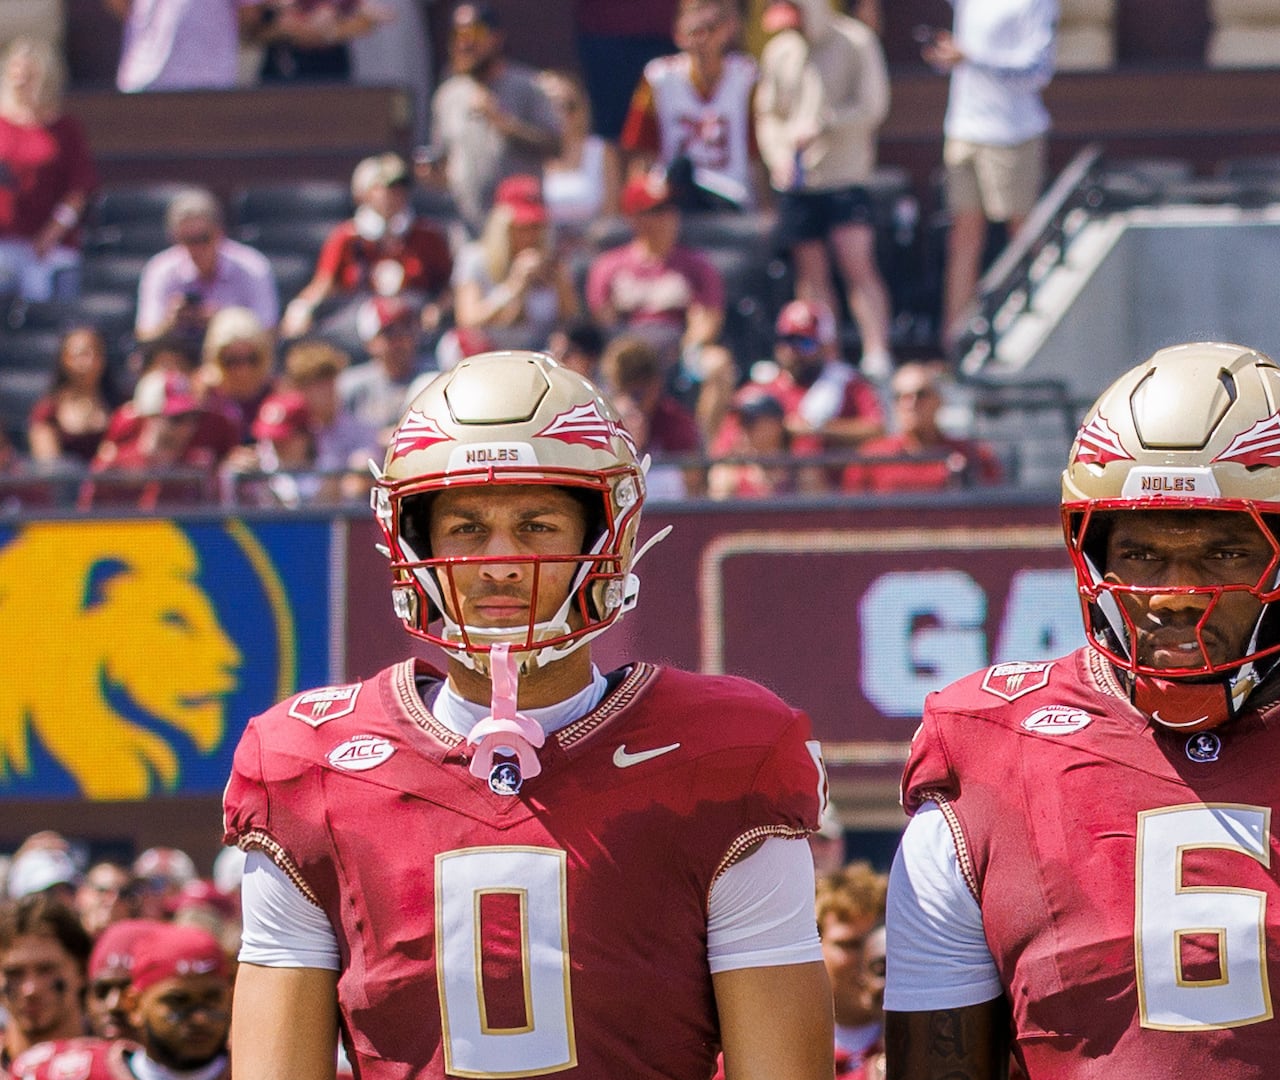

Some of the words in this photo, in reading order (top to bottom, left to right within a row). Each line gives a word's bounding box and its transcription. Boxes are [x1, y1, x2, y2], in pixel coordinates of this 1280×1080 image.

[466, 448, 519, 463] NOLES
[1141, 476, 1196, 491] NOLES
[1033, 713, 1083, 725] ACC
[338, 742, 387, 759] ACC
[1134, 802, 1274, 1032] 6
[434, 845, 578, 1080] 0
